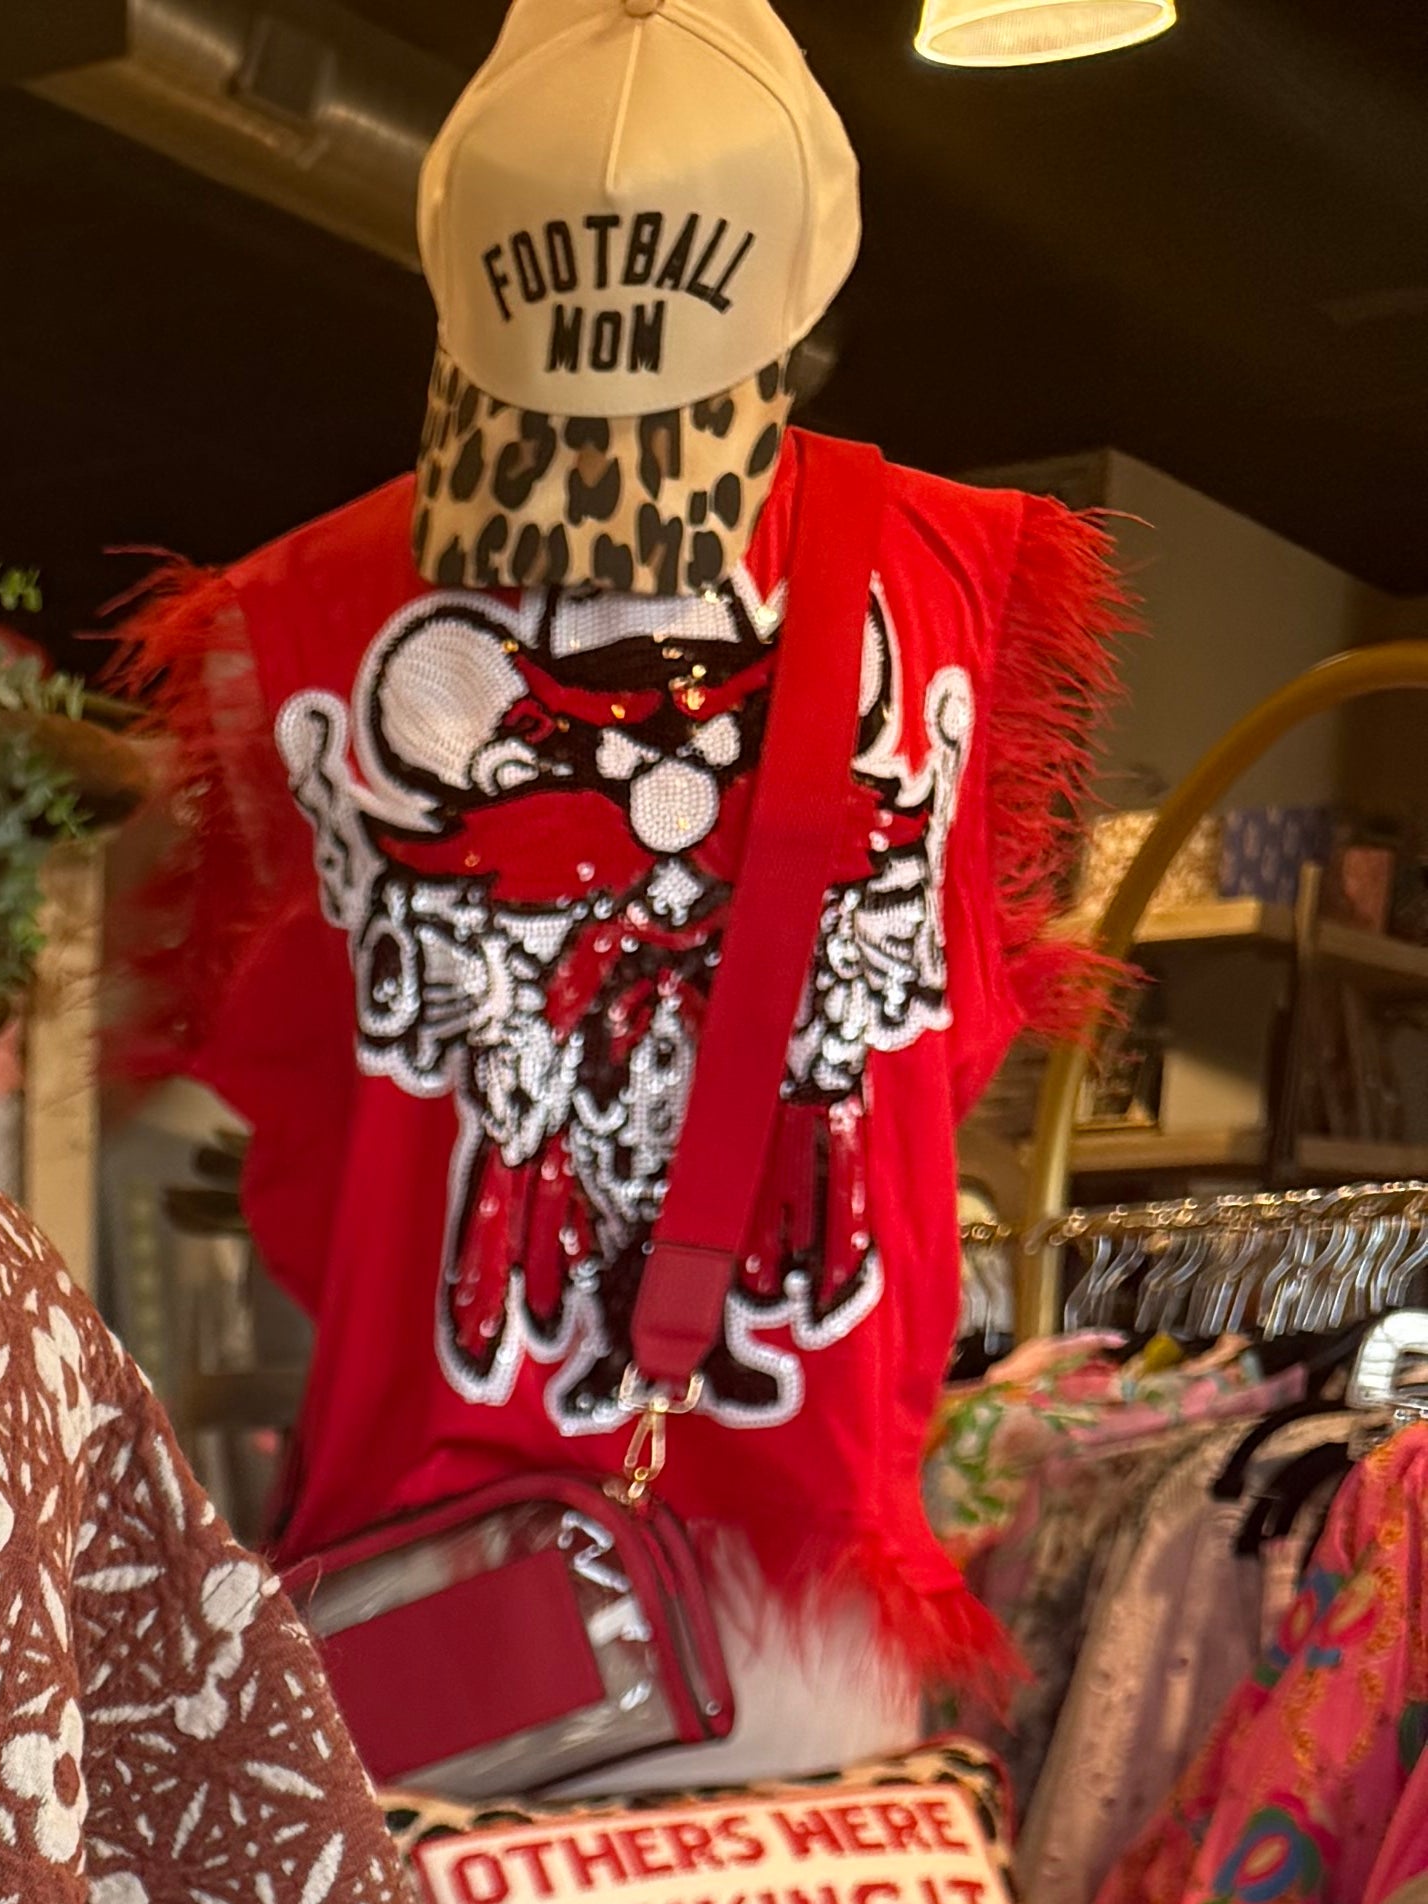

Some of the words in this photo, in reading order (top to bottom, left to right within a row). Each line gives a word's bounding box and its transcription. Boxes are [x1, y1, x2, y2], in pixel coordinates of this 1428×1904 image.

[480, 210, 756, 321] FOOTBALL
[544, 300, 665, 375] MOM
[770, 1800, 971, 1860] WERE
